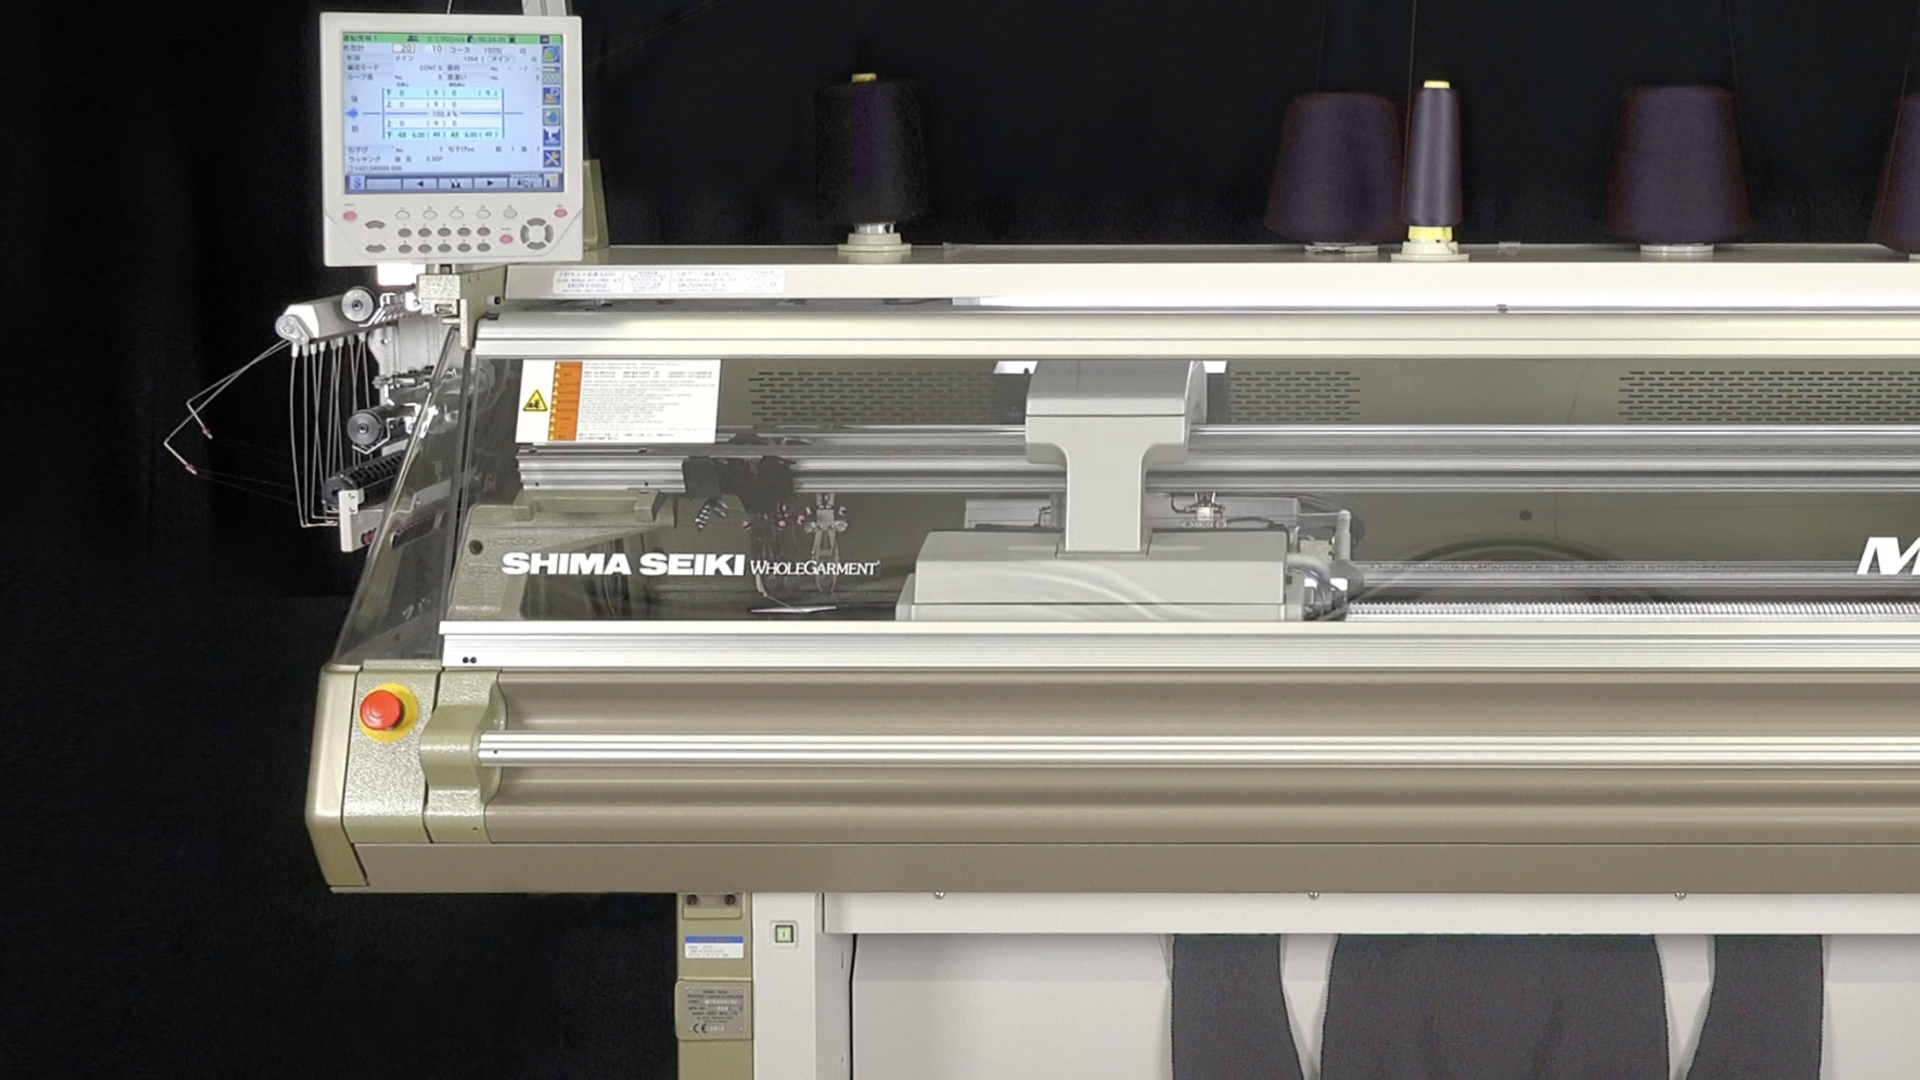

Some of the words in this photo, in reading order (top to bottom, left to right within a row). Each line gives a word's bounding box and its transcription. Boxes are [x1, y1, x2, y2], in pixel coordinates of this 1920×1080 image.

[432, 44, 443, 52] 10
[502, 552, 632, 575] SHIMA
[639, 552, 745, 576] SEIKI
[1856, 536, 1920, 576] M
